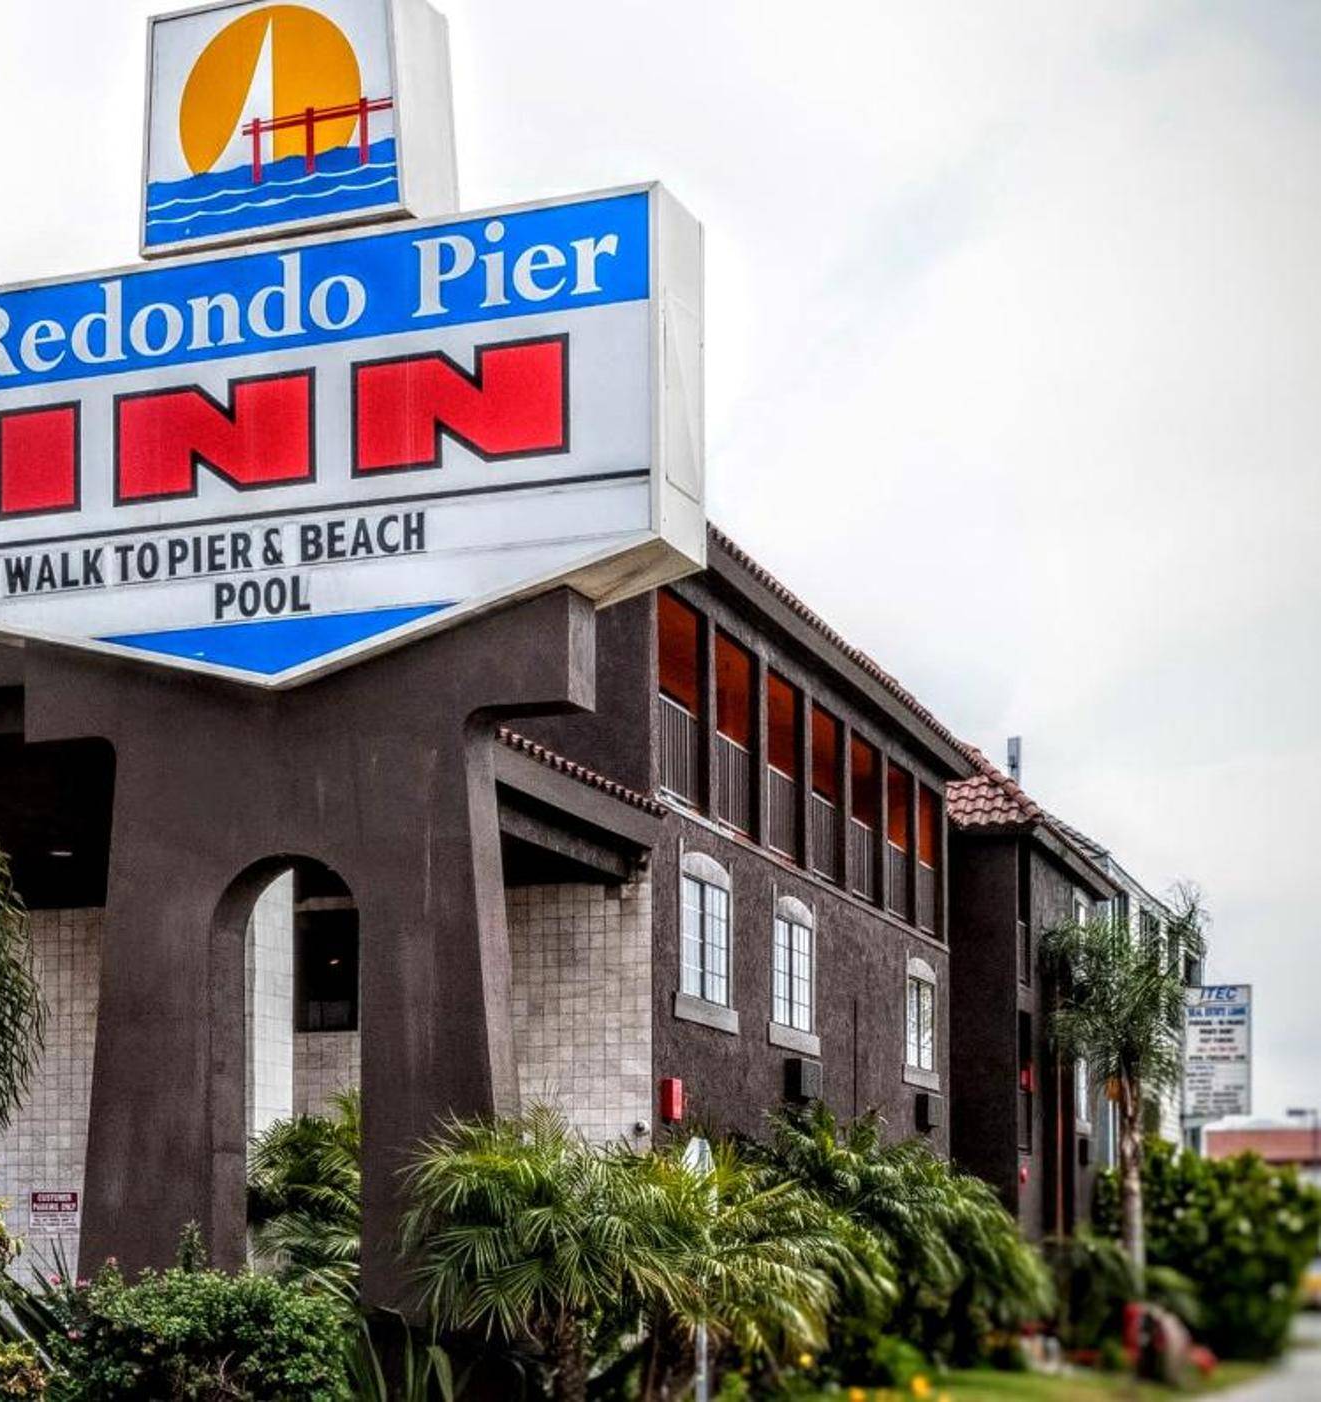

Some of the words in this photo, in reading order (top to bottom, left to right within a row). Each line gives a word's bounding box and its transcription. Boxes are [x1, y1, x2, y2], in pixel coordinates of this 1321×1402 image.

[411, 221, 619, 319] Pier
[4, 546, 105, 594] WALK
[114, 542, 161, 582] TO
[168, 532, 253, 576] PIER
[261, 527, 285, 566] &
[299, 512, 427, 563] BEACH
[214, 575, 312, 620] POOL
